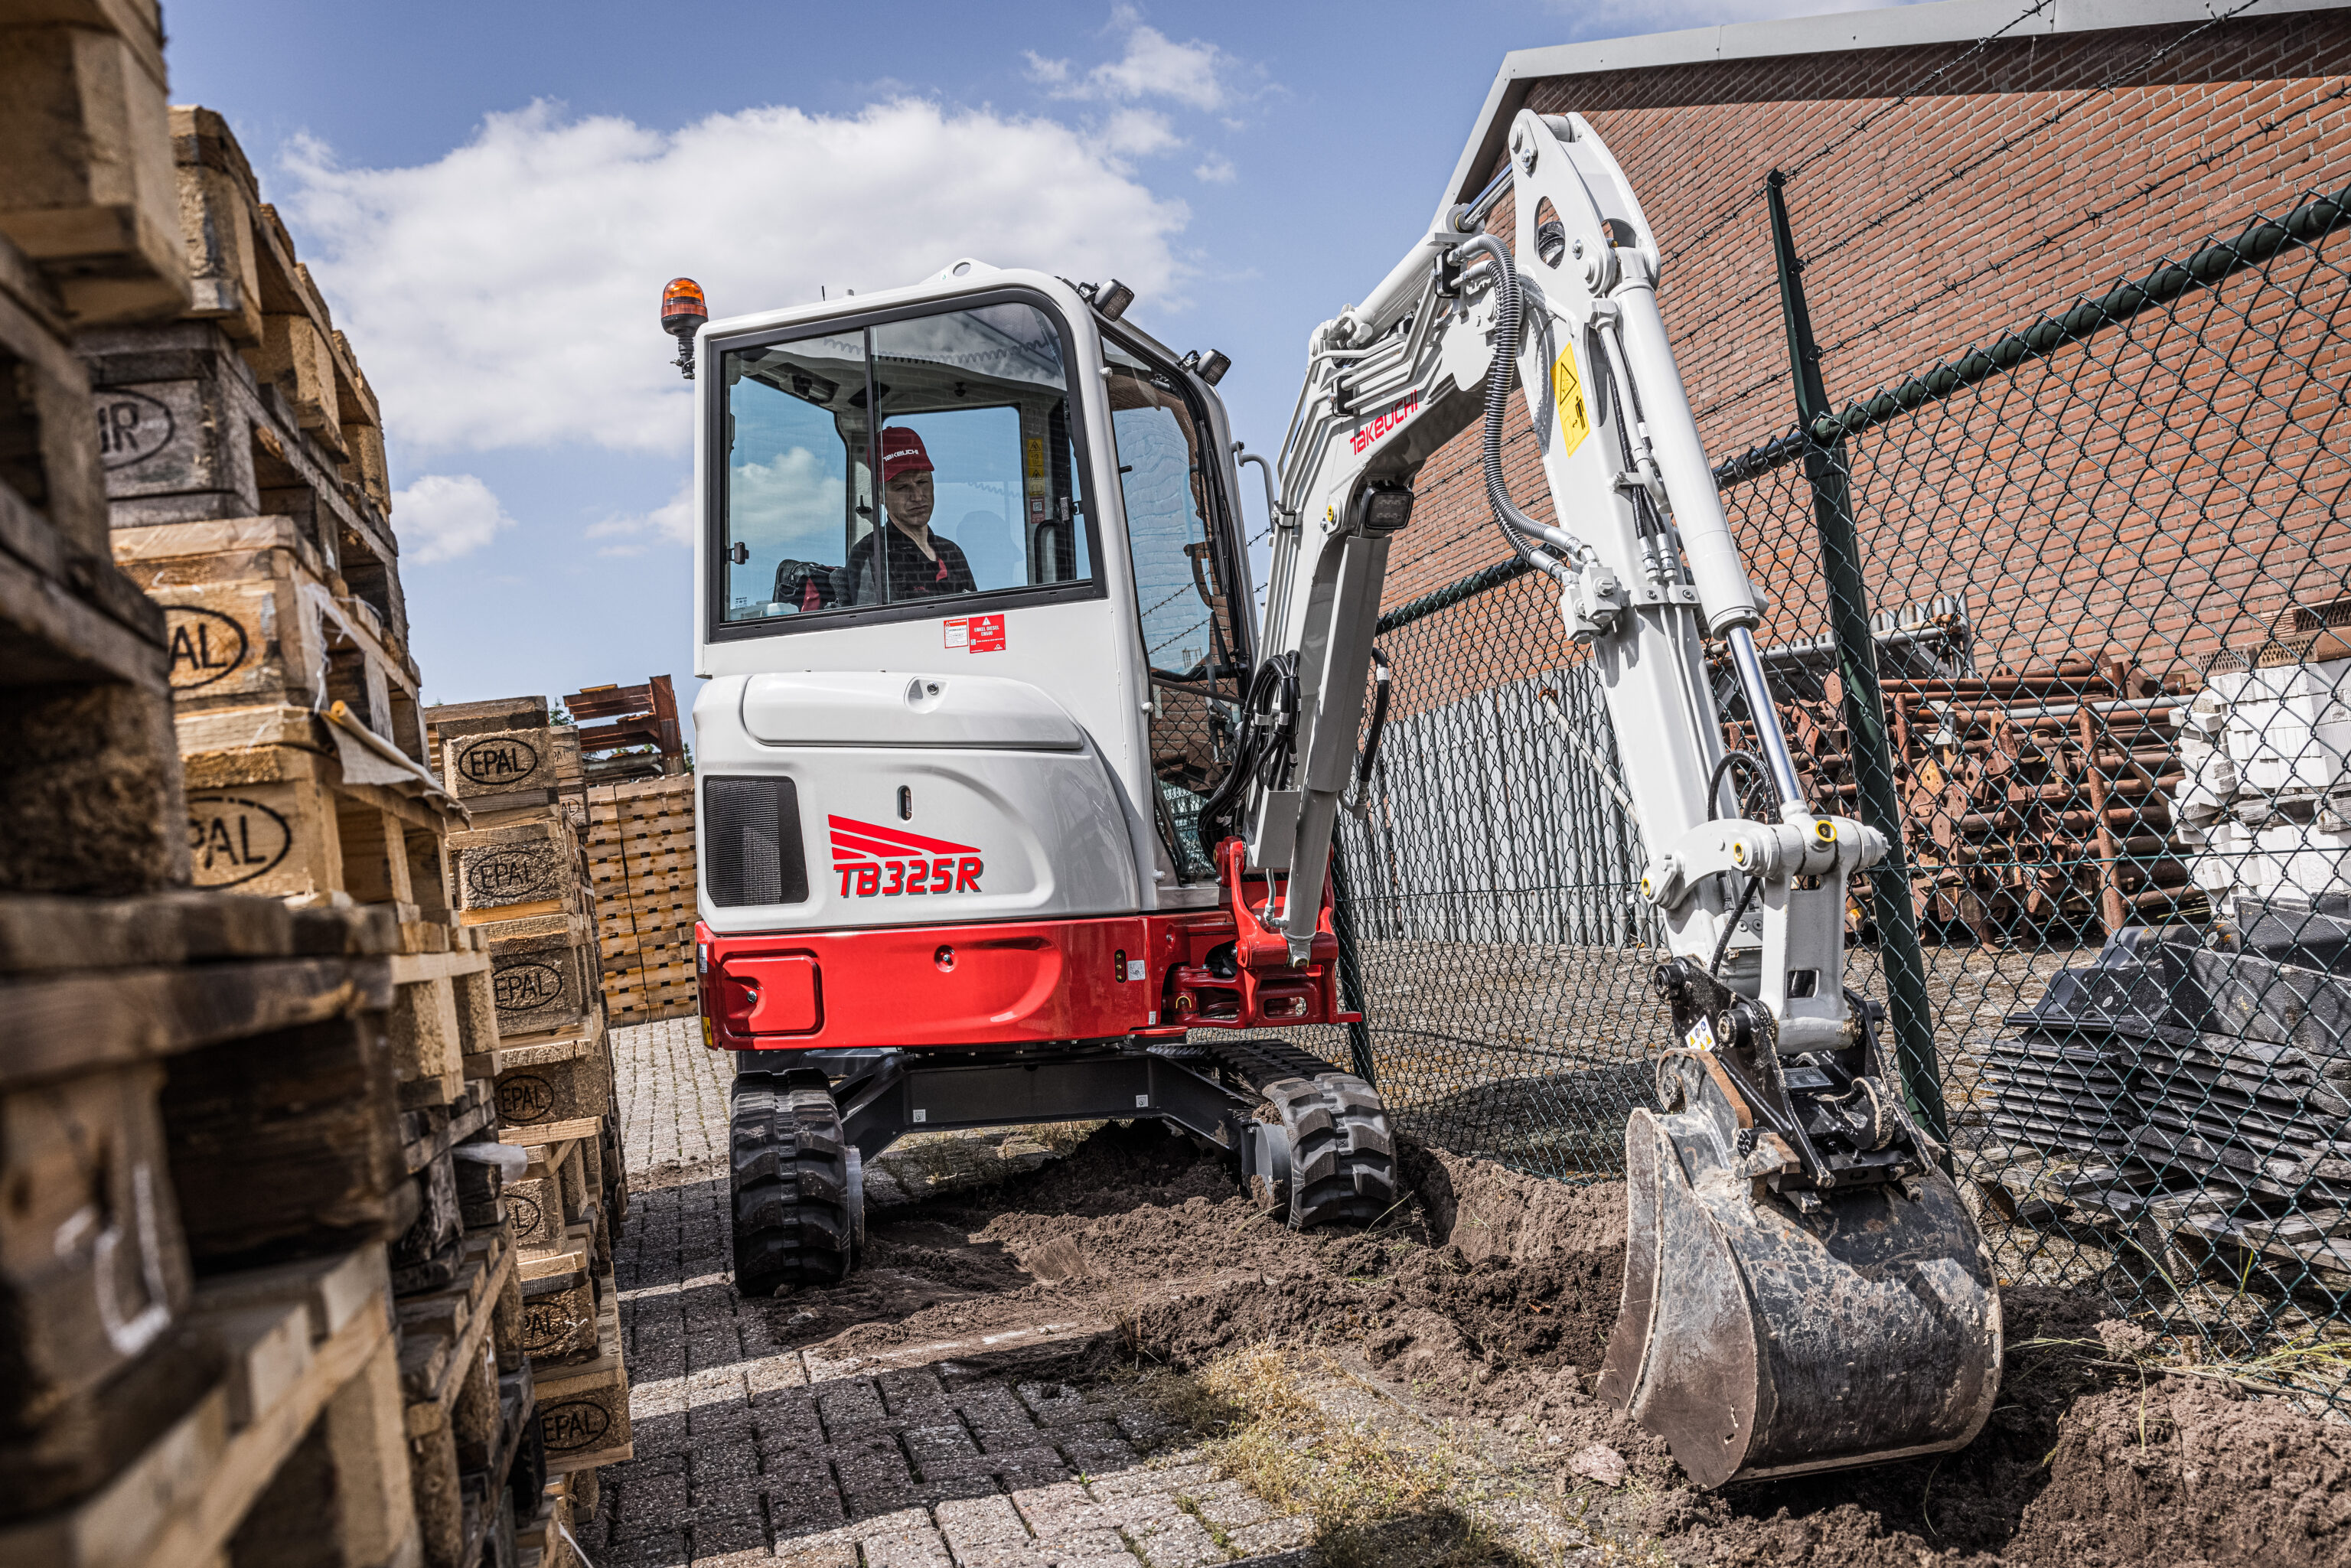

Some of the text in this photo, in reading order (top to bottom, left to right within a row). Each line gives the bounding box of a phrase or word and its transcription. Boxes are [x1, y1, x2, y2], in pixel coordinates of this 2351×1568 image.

[470, 748, 527, 776] EPAL
[833, 856, 984, 898] TB325R
[494, 971, 552, 1002] EPAL
[501, 1085, 546, 1112] EPAL
[541, 1409, 598, 1442] EPAL
